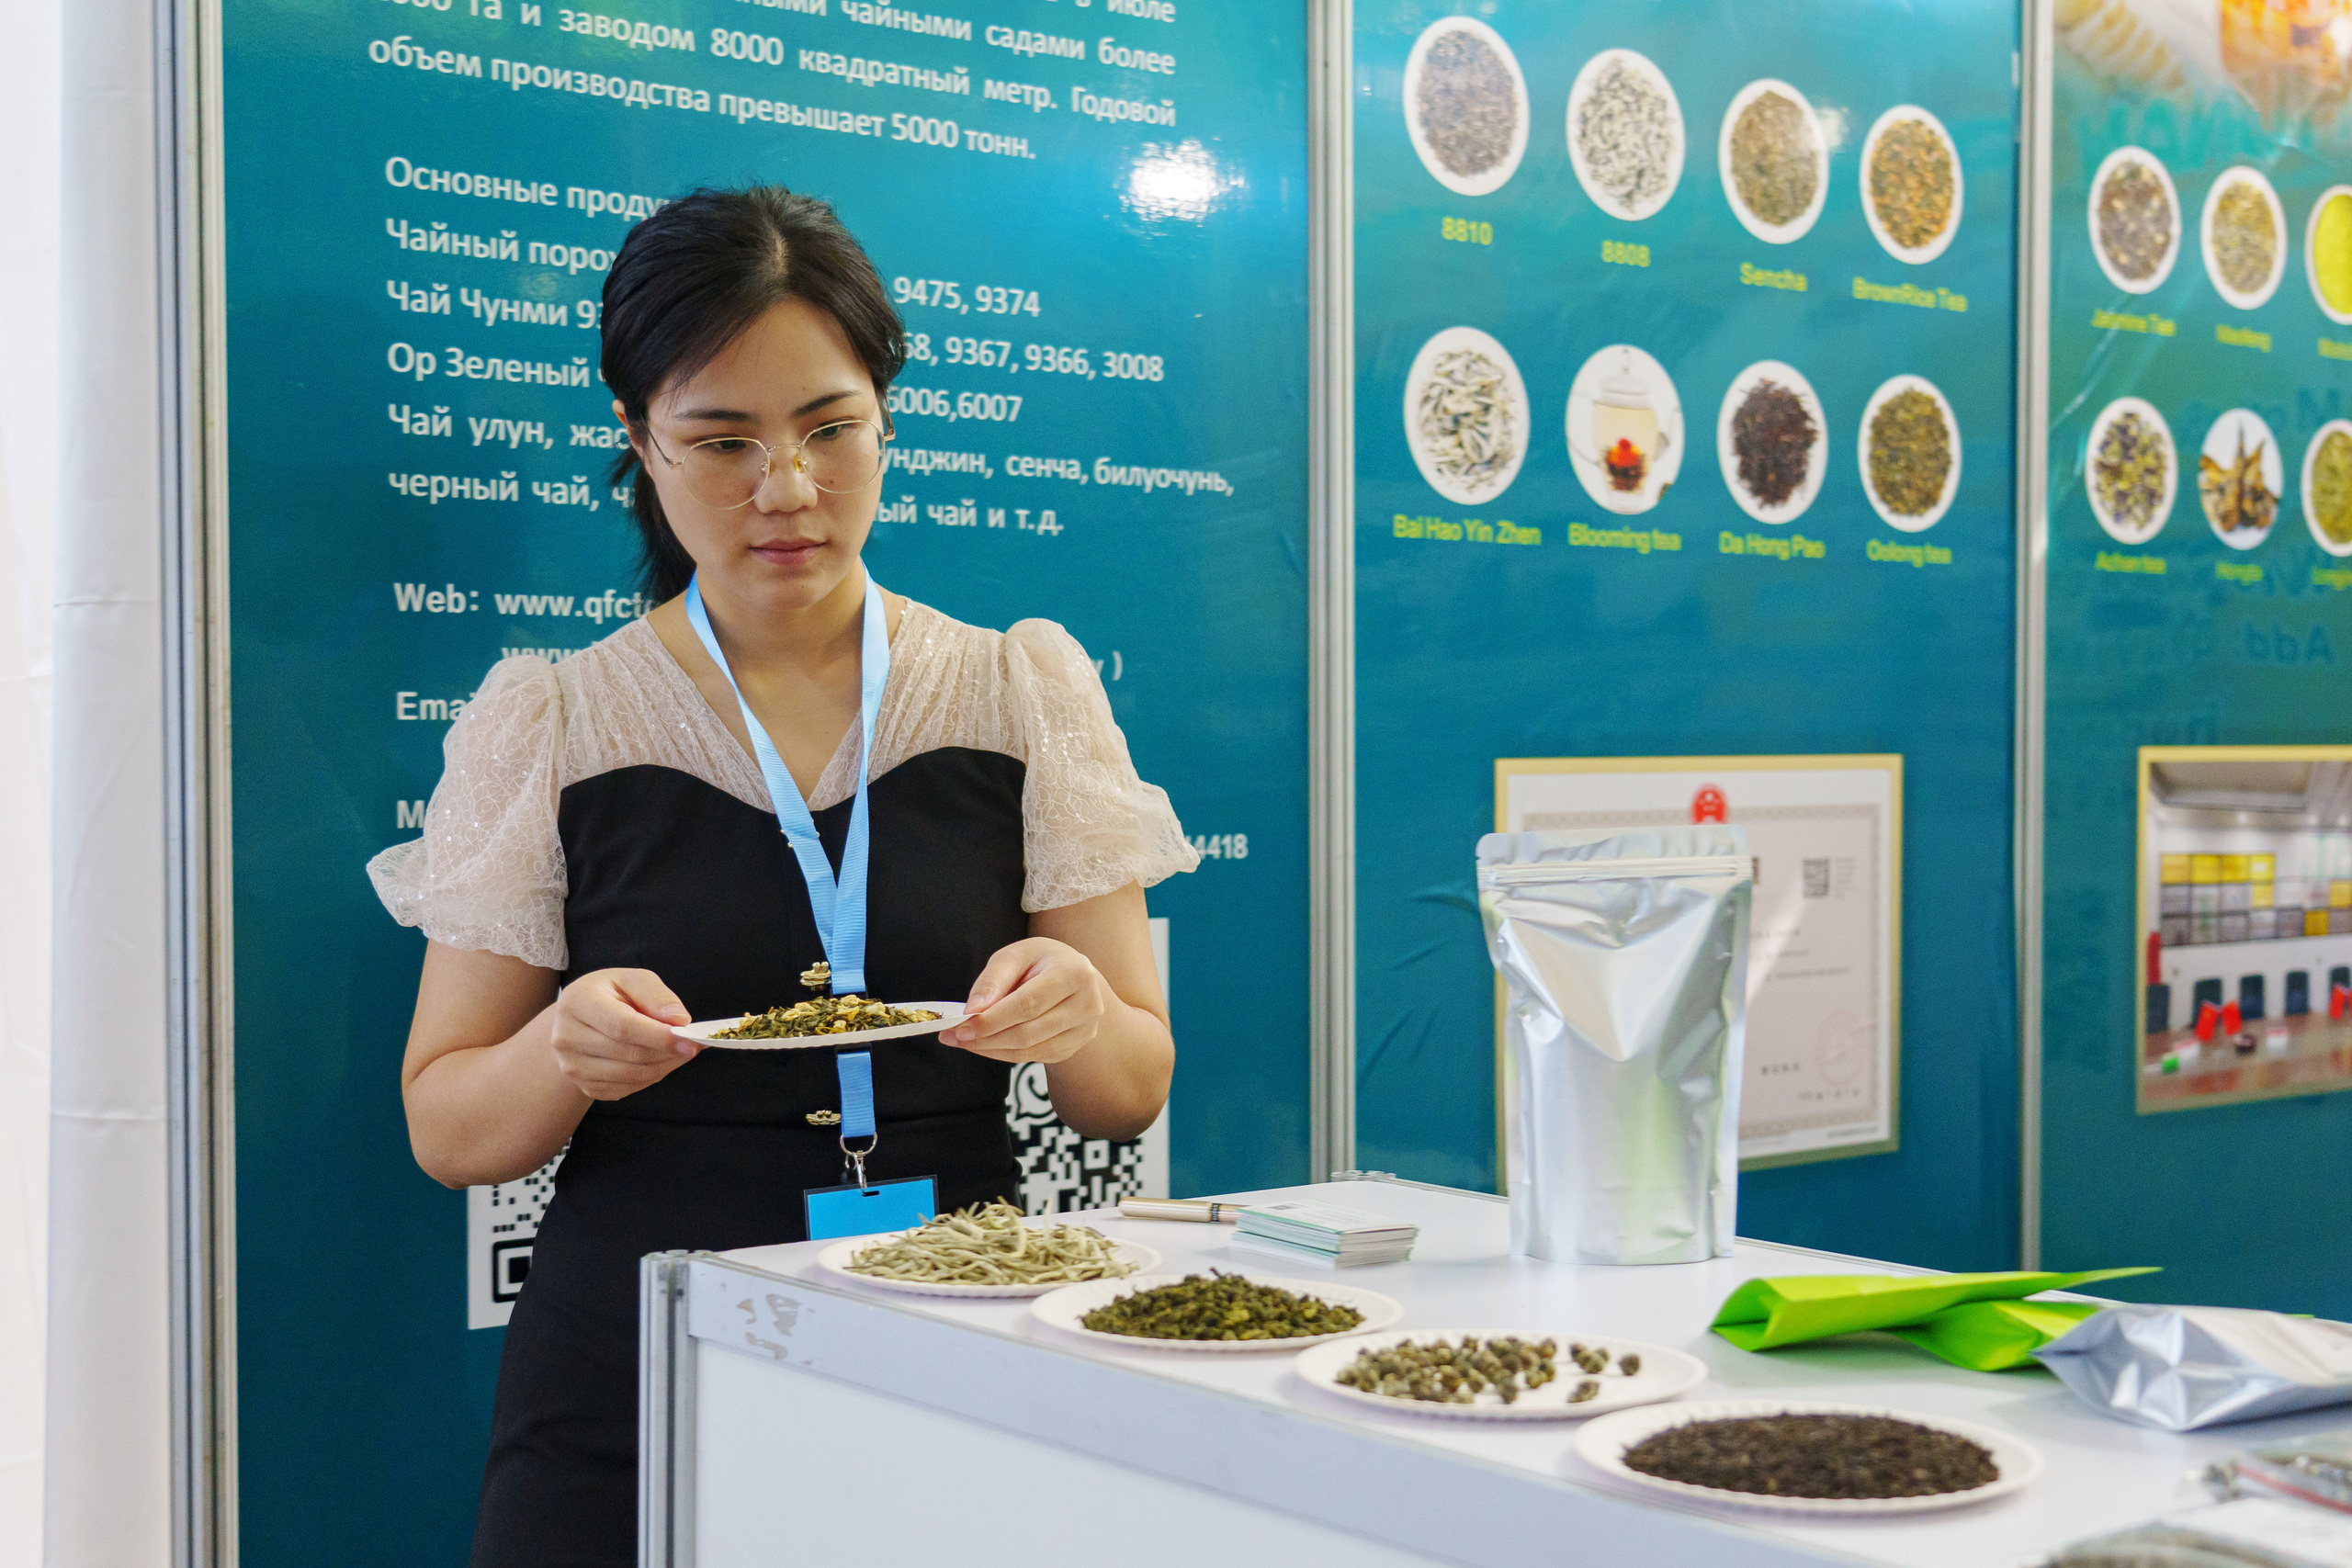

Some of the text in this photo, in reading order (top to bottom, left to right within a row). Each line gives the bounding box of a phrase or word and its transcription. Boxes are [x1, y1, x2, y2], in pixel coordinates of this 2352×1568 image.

[841, 0, 972, 41] чайными
[985, 25, 1086, 61] садами
[1097, 36, 1177, 75] более
[520, 2, 541, 27] и
[559, 8, 695, 52] заводом
[710, 28, 785, 66] 8000
[798, 49, 971, 96] квадратный
[983, 78, 1058, 114] метр.
[1071, 85, 1176, 127] Годовой
[368, 34, 1036, 160] объем производства превышает 5000 тонн.
[385, 156, 669, 221] Основные проду
[1442, 216, 1493, 245] 8810
[385, 218, 519, 262] Чайный
[893, 276, 969, 315] 9475,
[975, 285, 1042, 318] 9374
[386, 279, 451, 315] Чай
[459, 287, 568, 327] Чунми
[944, 335, 1019, 374] 9367,
[1024, 343, 1096, 380] 9366,
[1102, 350, 1165, 382] 3008
[387, 342, 437, 382] Ор
[445, 346, 590, 388] Зеленый
[388, 403, 452, 437] Чай
[468, 416, 554, 450] улун,
[569, 423, 630, 450] жас
[1005, 455, 1089, 485] сенча,
[1093, 456, 1235, 497] билуочунь,
[389, 470, 519, 505] черный
[531, 475, 600, 512] чай,
[873, 495, 917, 524] ый
[927, 498, 978, 527] чай
[987, 508, 1006, 528] и
[1014, 508, 1065, 536] т.д.
[1393, 513, 1542, 546] Bai Hao Yin Zhen
[1568, 523, 1681, 555] Blooming tea
[1719, 531, 1745, 555] Da
[1866, 538, 1925, 568] Oolong
[393, 582, 479, 614] Web:
[396, 691, 476, 720] Ema
[1185, 833, 1249, 860] 4418
